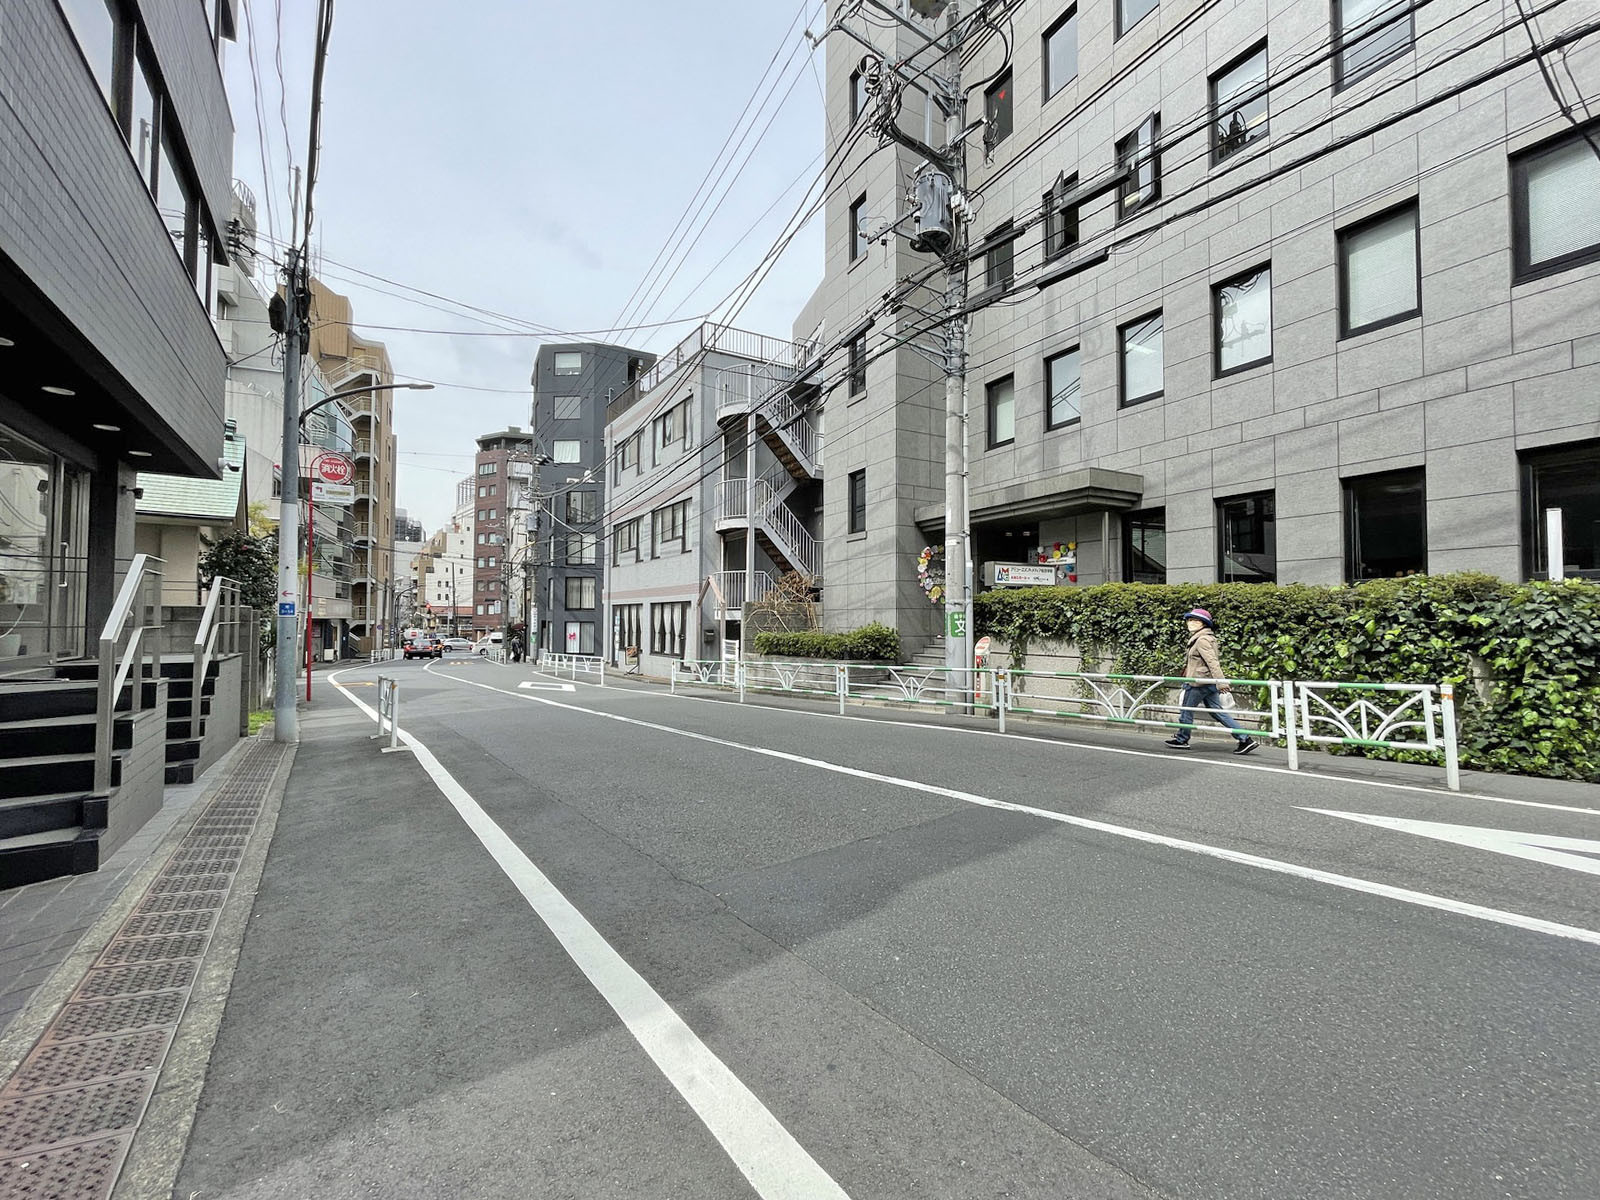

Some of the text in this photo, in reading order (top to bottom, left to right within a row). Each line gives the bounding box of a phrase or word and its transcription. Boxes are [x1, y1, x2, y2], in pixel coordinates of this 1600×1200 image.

[321, 463, 346, 476] 消火栓
[954, 619, 966, 632] 文
